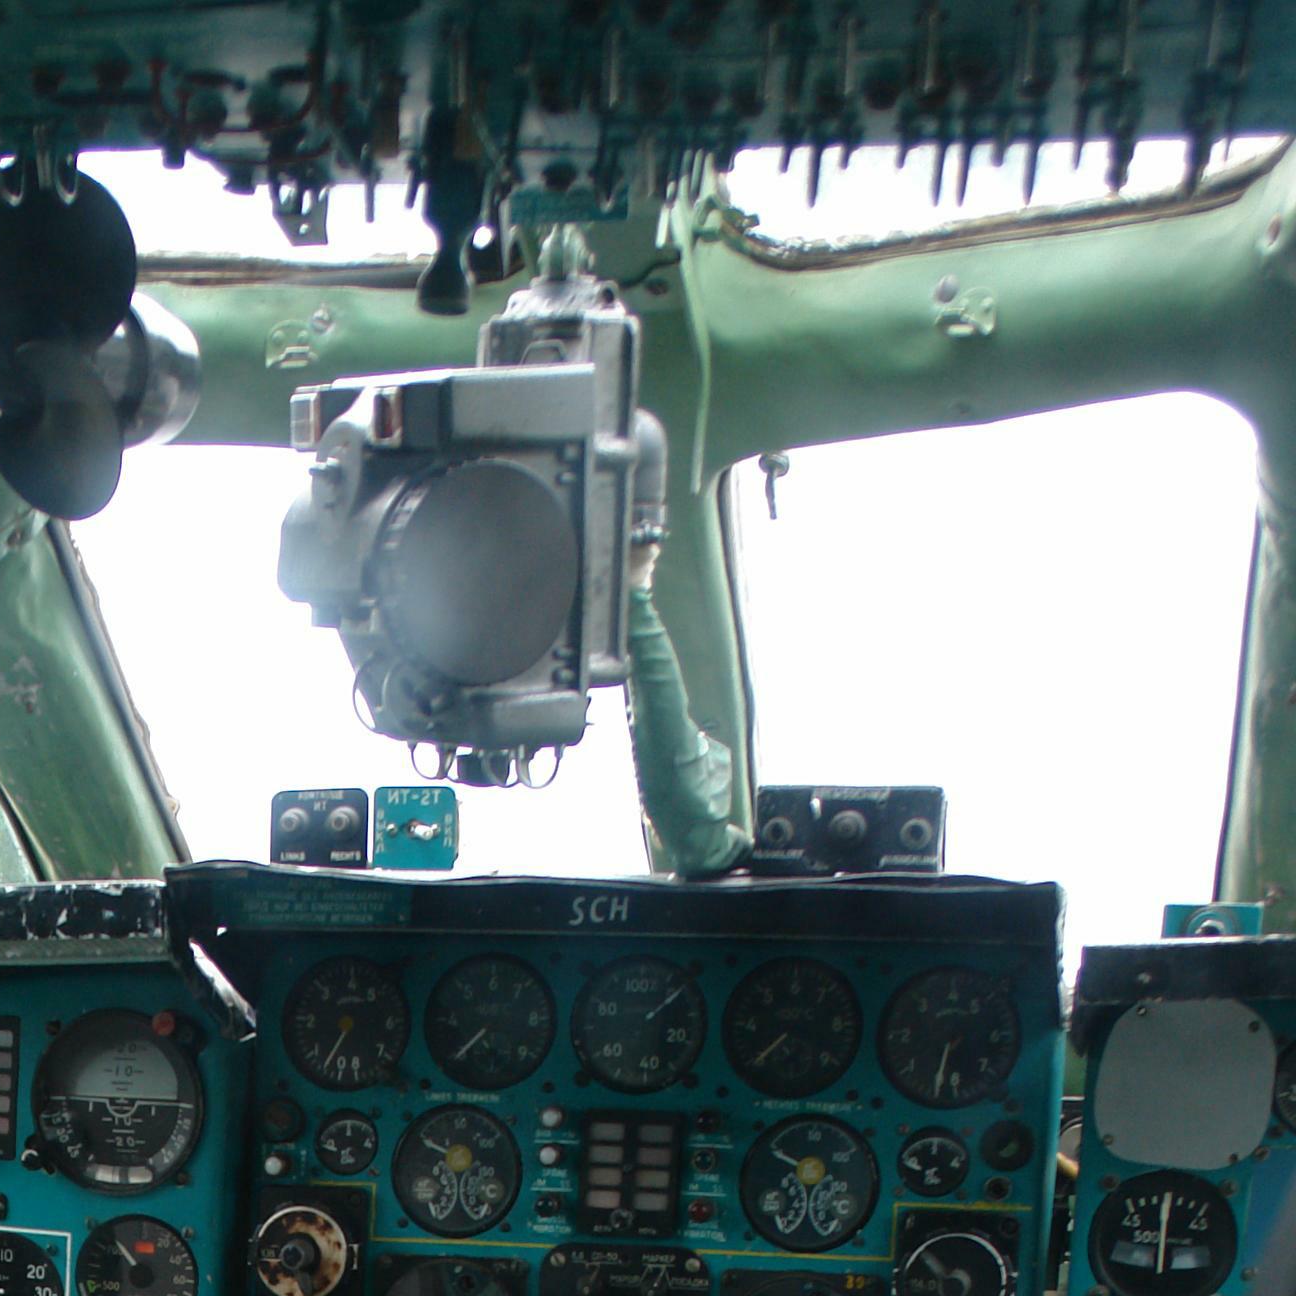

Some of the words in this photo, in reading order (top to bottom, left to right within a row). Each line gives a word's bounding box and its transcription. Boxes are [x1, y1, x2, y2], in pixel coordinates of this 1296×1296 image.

[568, 896, 630, 926] SCH
[488, 976, 498, 990] 6
[463, 983, 473, 999] 5
[512, 983, 523, 998] 7
[597, 1001, 618, 1016] 80
[306, 1014, 316, 1028] 2
[385, 1016, 395, 1030] 6
[528, 1011, 539, 1026] 8
[666, 1027, 686, 1043] 20
[376, 1043, 385, 1057] 7
[518, 1045, 528, 1060] 9
[602, 1042, 623, 1057] 60
[336, 1056, 346, 1070] 0
[351, 1056, 360, 1070] 8
[639, 1055, 659, 1070] 40
[950, 1072, 960, 1087] 8
[115, 1136, 135, 1146] 20
[0, 1248, 13, 1262] 10
[102, 1281, 120, 1291] 500
[172, 1275, 185, 1285] 60
